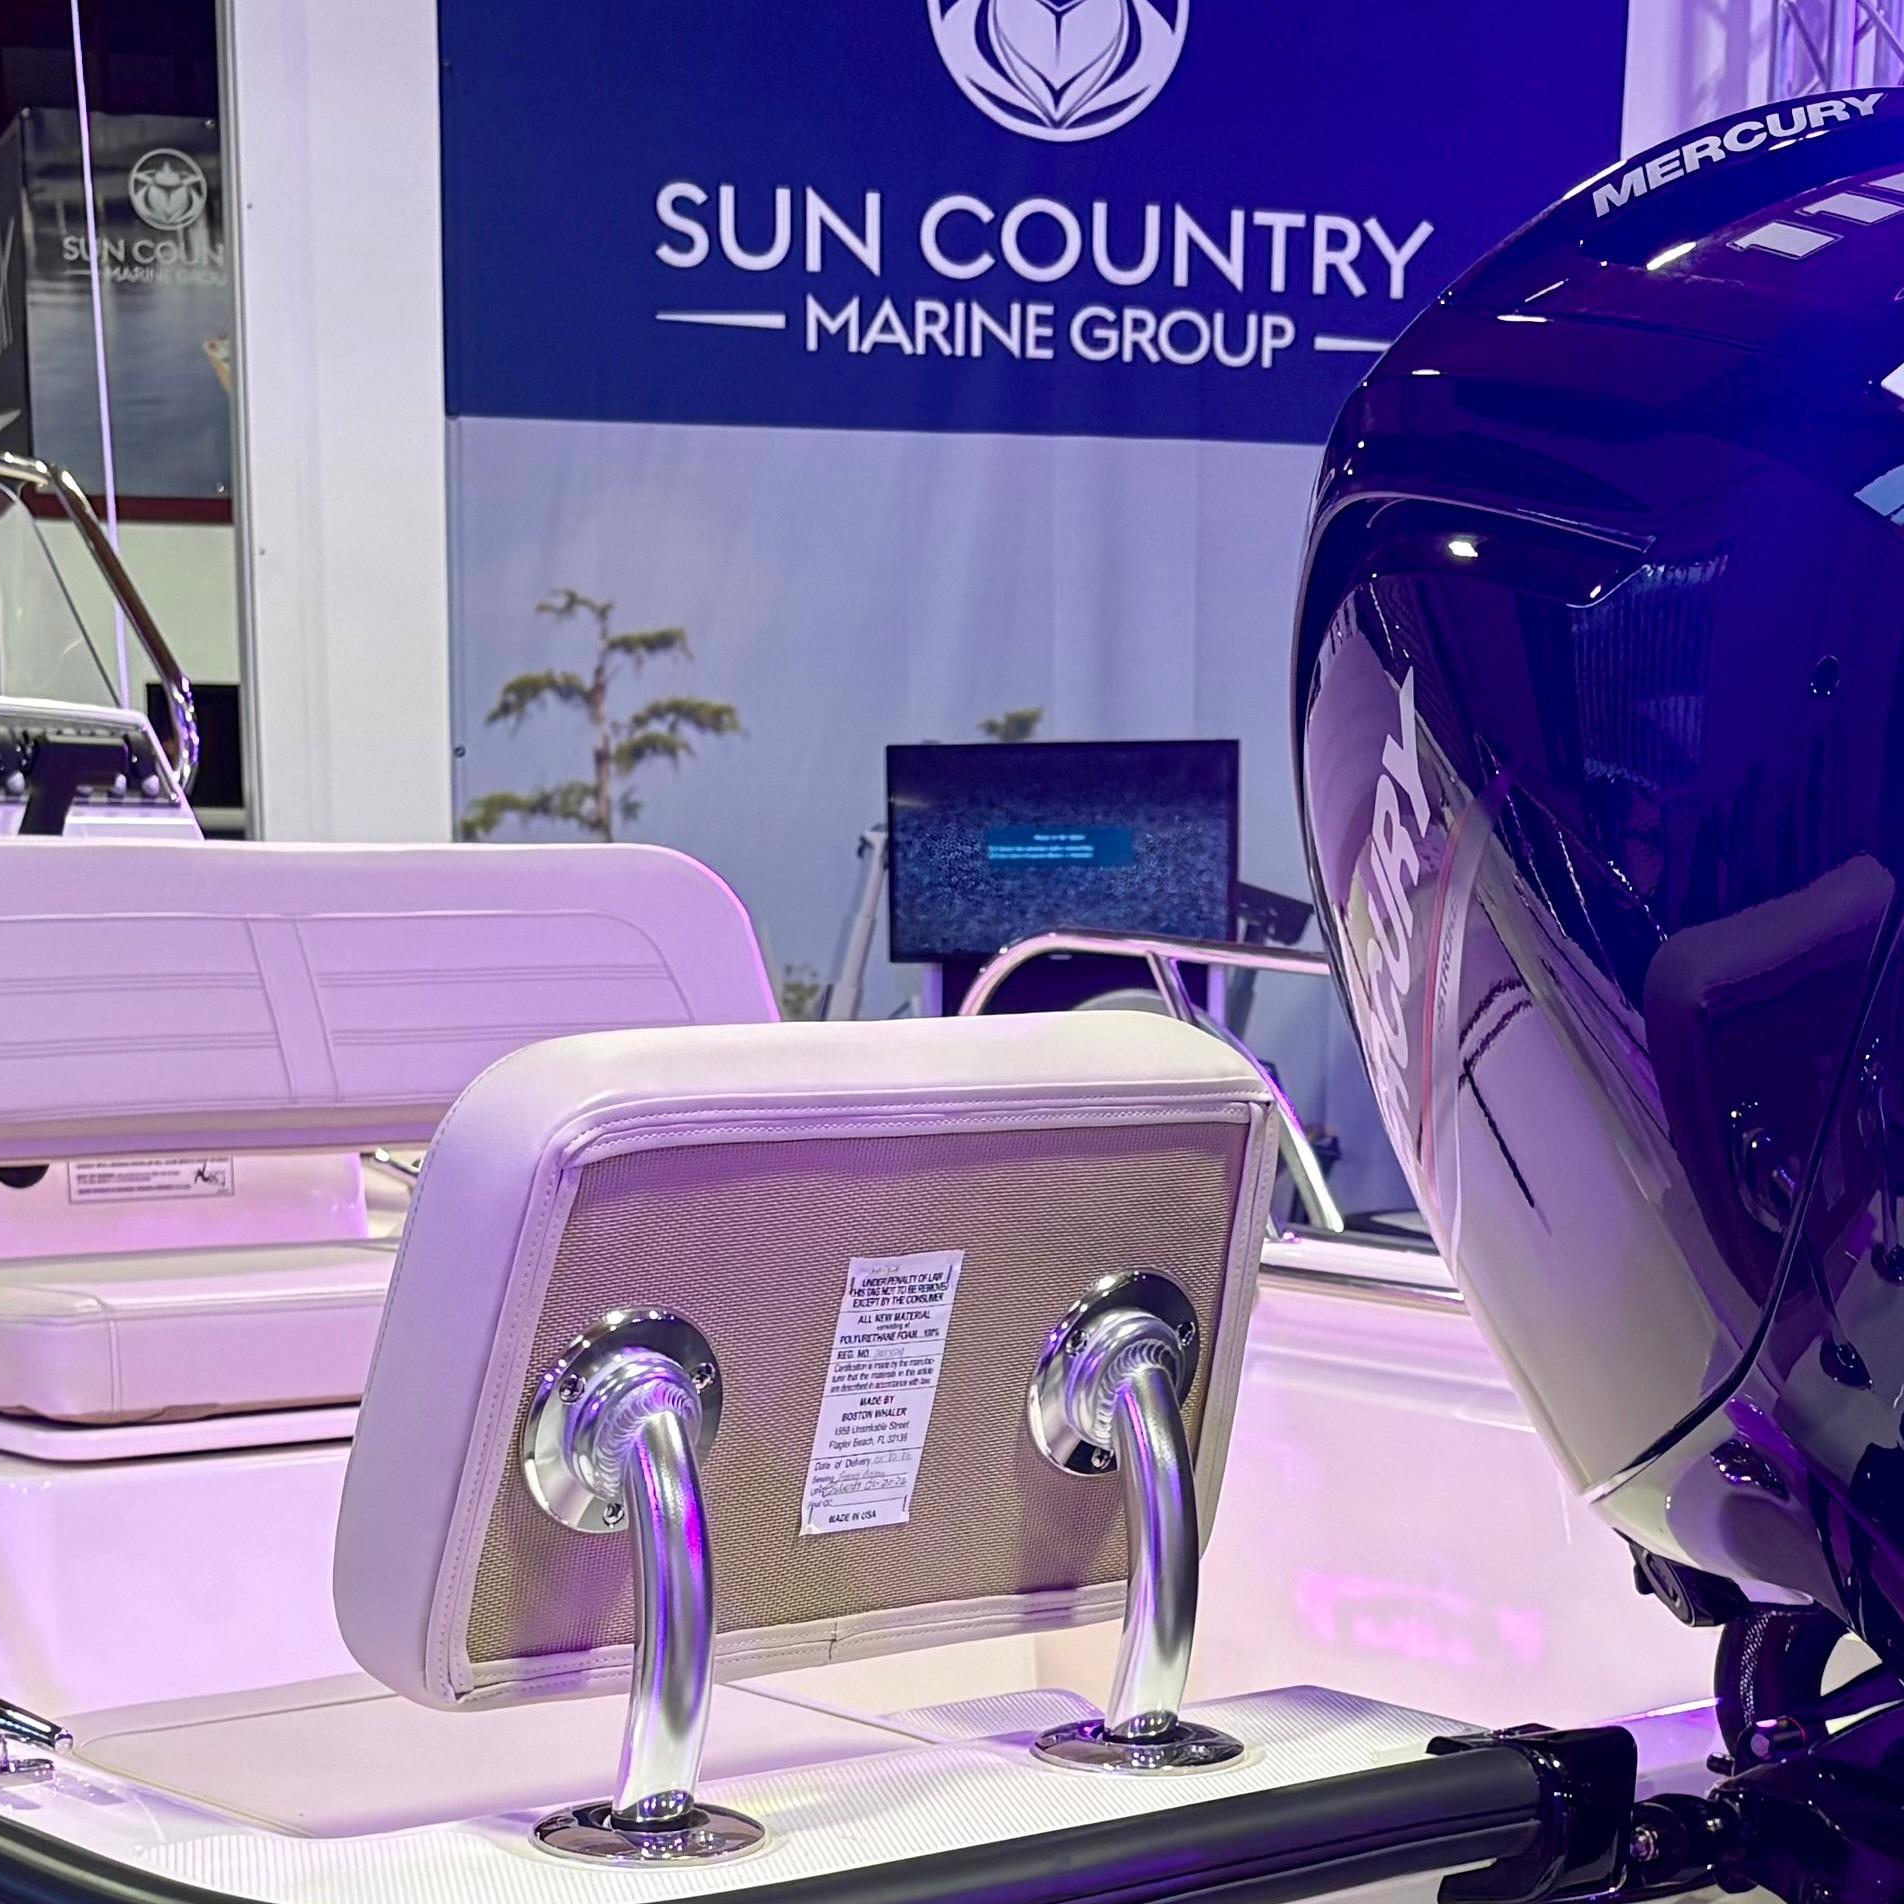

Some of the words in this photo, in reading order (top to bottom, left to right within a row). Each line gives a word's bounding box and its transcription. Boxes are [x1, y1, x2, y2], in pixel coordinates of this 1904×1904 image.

[1593, 92, 1888, 218] MERCURY
[654, 181, 881, 277] SUN
[919, 195, 1435, 300] COUNTRY
[804, 293, 1055, 361] MARINE
[1069, 306, 1296, 369] GROUP
[841, 1410, 874, 1422] BOSTON
[874, 1407, 908, 1418] WHALER
